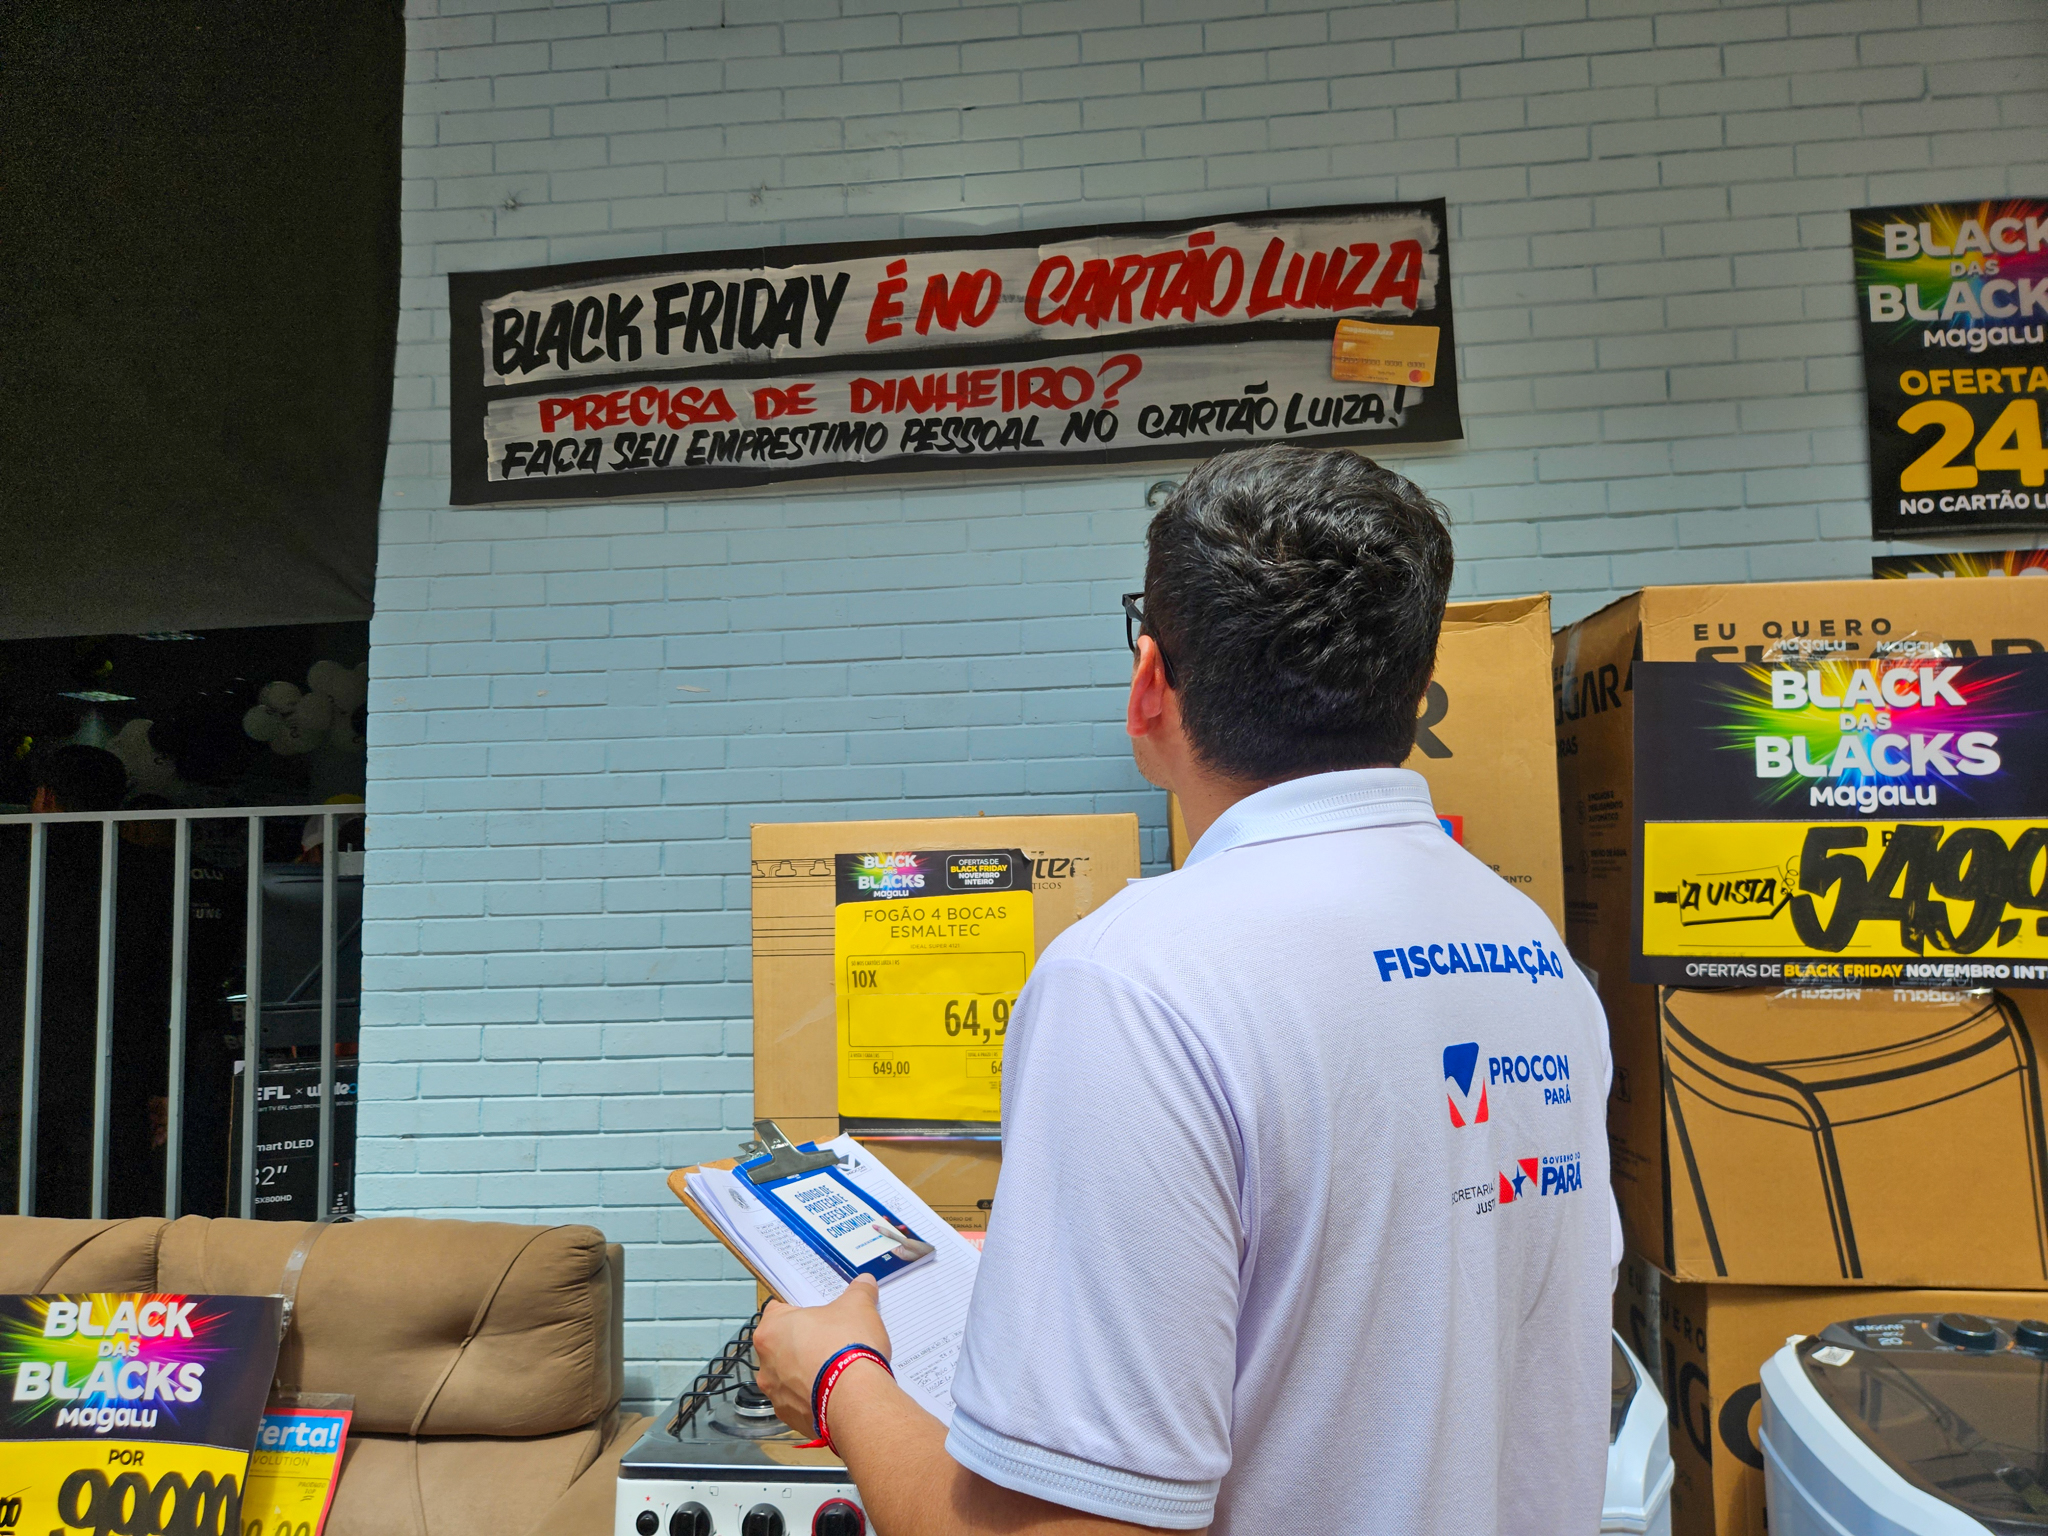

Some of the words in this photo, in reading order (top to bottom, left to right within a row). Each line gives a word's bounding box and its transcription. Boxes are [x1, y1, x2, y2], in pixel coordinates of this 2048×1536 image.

[1949, 259, 2000, 279] DAS
[492, 292, 643, 376] BLACK
[653, 271, 851, 356] FRIDAY
[865, 258, 908, 344] É
[914, 267, 1002, 336] NO
[1024, 231, 1245, 330] CARTÃO
[1245, 236, 1423, 319] LUIZA
[538, 385, 738, 433] PRECISA
[752, 383, 819, 421] DE
[849, 353, 1143, 414] DINHEIRO?
[607, 431, 679, 472] SEU
[685, 420, 889, 465] EMPRESTIMO
[900, 415, 1044, 454] PESSOAL
[1060, 409, 1119, 447] NO
[1137, 380, 1279, 440] CARTÃO
[1284, 385, 1407, 438] LUIZA!
[1897, 398, 2048, 493] 24
[1900, 497, 1935, 515] NO
[1939, 489, 2030, 512] CARTÃO
[1693, 623, 1737, 642] EU
[1762, 617, 1892, 640] QUERO
[1771, 665, 1967, 710] BLACK
[1839, 712, 1891, 731] DAS
[1755, 731, 2001, 778] BLACKS
[1809, 784, 1937, 813] Magalu
[864, 855, 917, 868] BLACK
[979, 864, 1008, 872] FRIDAY
[858, 874, 925, 889] BLACKS
[958, 871, 1000, 879] NOVEMBRO
[1501, 875, 1532, 883] ENTO
[1706, 876, 1777, 907] VISTA
[864, 906, 925, 922] FOGÃO
[931, 908, 941, 921] 4
[948, 906, 1007, 920] BOCAS
[890, 924, 980, 938] ESMALTEC
[1373, 940, 1564, 984] FISCALIZAÇÃO
[1685, 963, 1757, 978] OFERTAS
[1759, 963, 1781, 978] DE
[1784, 964, 1840, 978] BLACK
[1844, 964, 1903, 978] FRIDAY
[1906, 964, 2010, 979] NOVEMBRO
[2014, 965, 2048, 980] INT
[852, 970, 877, 988] 10X
[944, 998, 1018, 1044] 64,9
[873, 1061, 910, 1077] 649,00
[1488, 1054, 1570, 1085] PROCON
[1544, 1084, 1571, 1105] PARÁ
[284, 1139, 314, 1150] DLED
[1543, 1155, 1573, 1165] GOVERNO
[795, 1185, 821, 1204] CÓDIGO
[819, 1184, 834, 1197] DE
[819, 1206, 848, 1225] DEFESA
[843, 1203, 858, 1216] DO
[826, 1212, 876, 1238] CONSUMIDOR
[43, 1301, 198, 1338] BLACK
[98, 1341, 140, 1357] DAS
[1878, 1337, 1903, 1347] 20
[13, 1361, 206, 1402] BLACKS
[828, 1369, 839, 1387] dos
[56, 1407, 158, 1433] Magalu
[108, 1449, 144, 1466] POR
